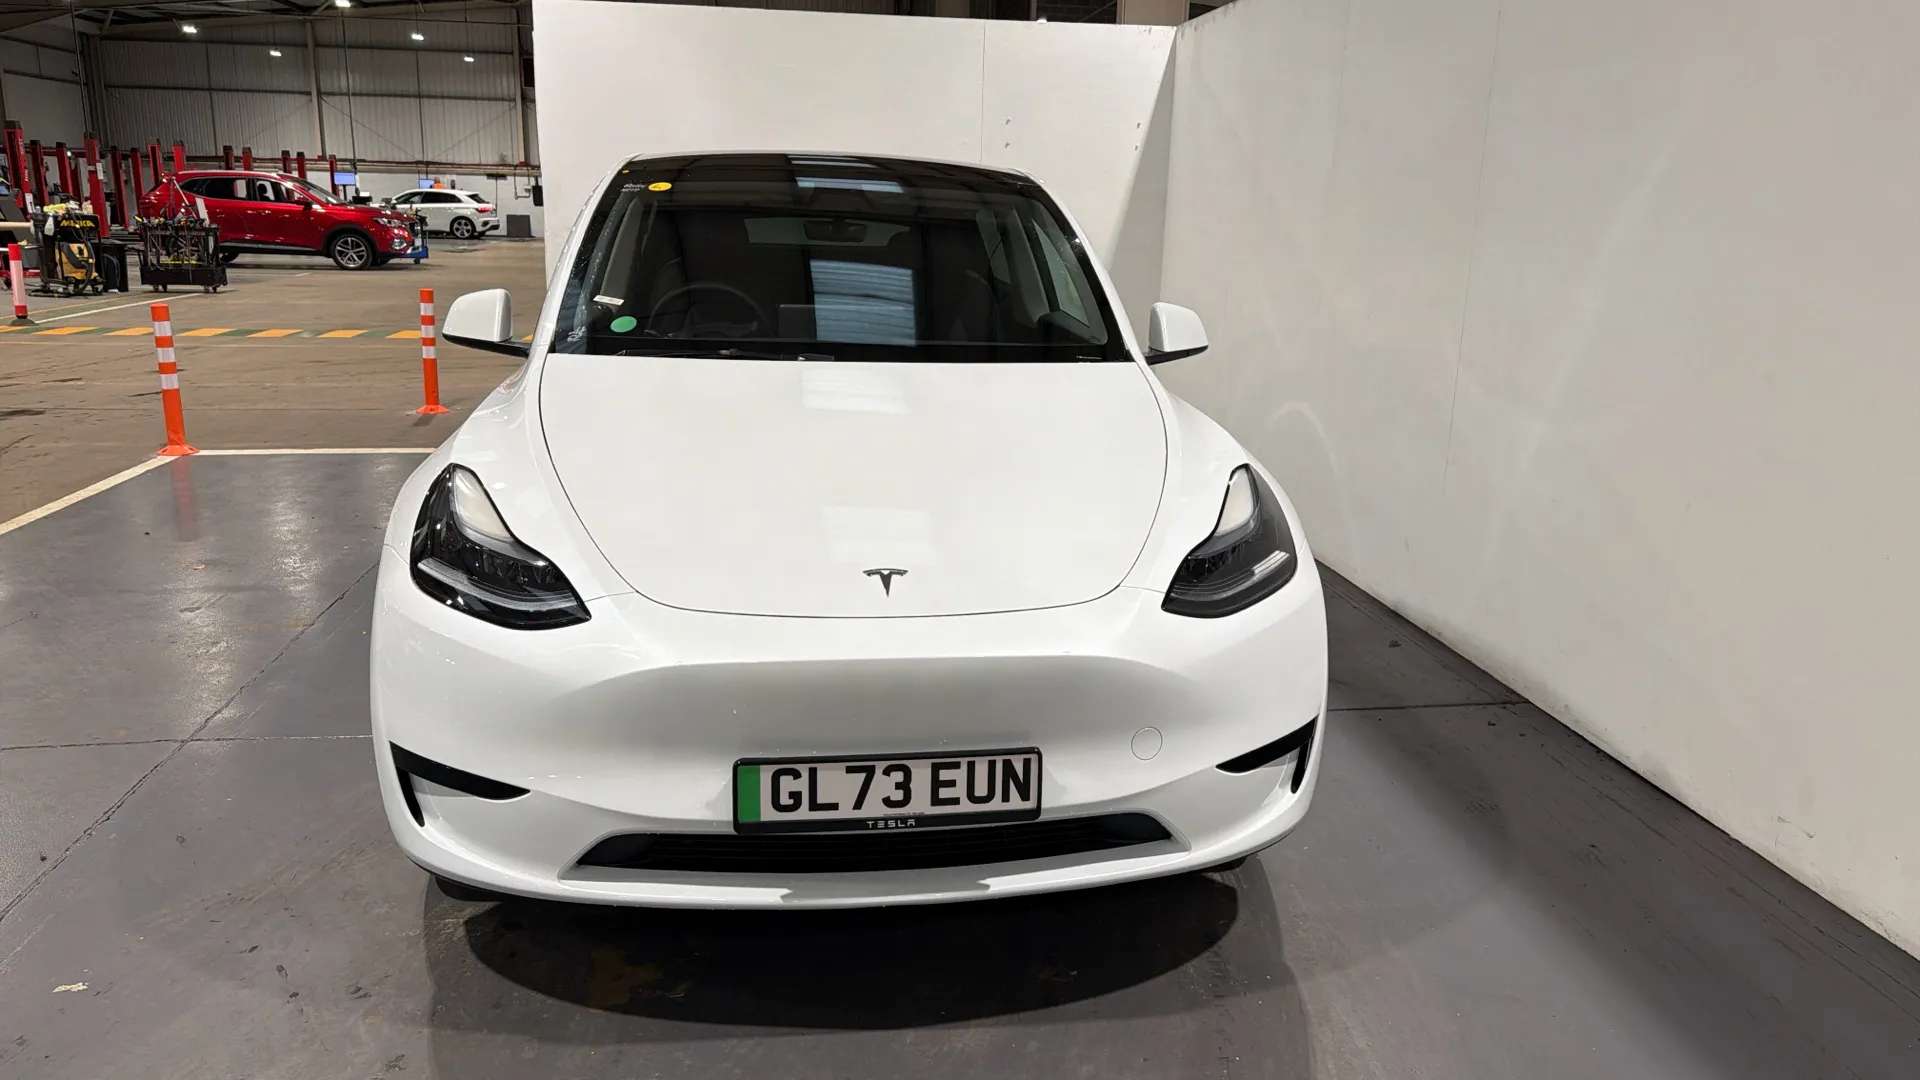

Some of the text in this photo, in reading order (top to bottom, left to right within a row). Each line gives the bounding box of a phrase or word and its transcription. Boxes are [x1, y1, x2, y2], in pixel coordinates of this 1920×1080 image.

[771, 758, 1031, 812] GL73 EUN
[866, 819, 916, 829] TESLA
